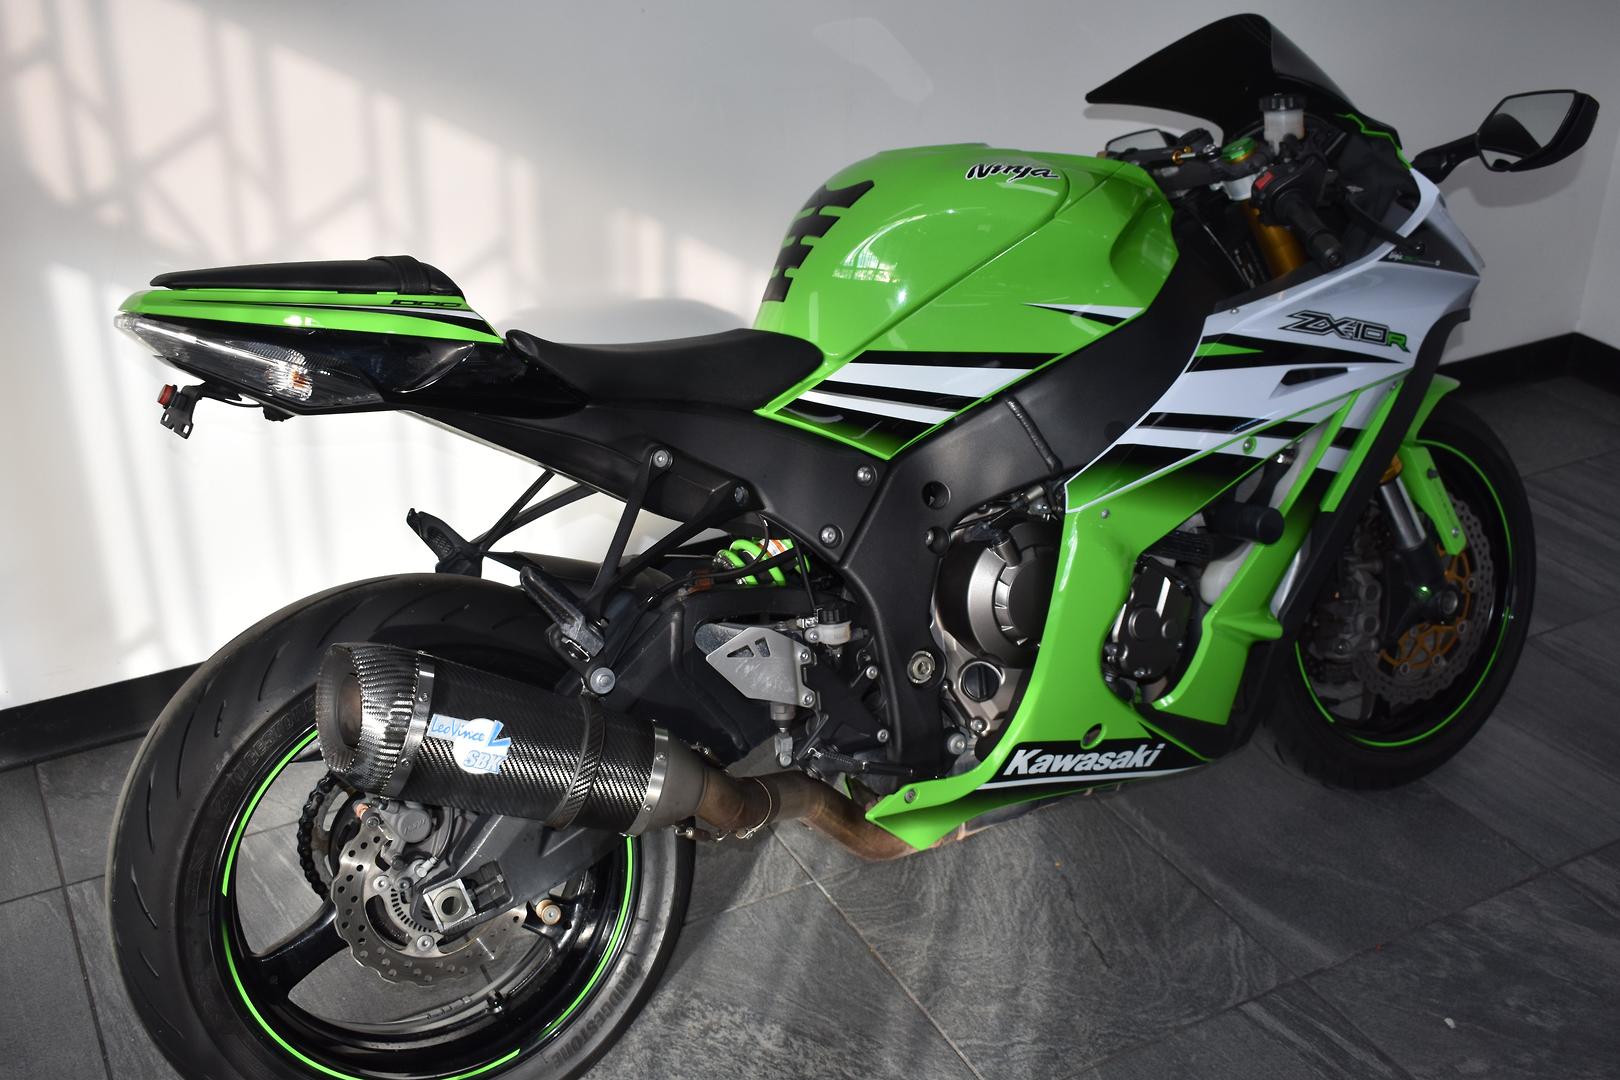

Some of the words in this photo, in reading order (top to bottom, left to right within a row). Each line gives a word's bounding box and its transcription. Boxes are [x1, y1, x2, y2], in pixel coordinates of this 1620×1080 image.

[966, 161, 1060, 184] Ninja
[430, 715, 485, 742] LeoVince
[464, 750, 506, 773] SBK
[1003, 743, 1165, 776] Kawasaki
[551, 958, 643, 1069] BRIDGESTONE
